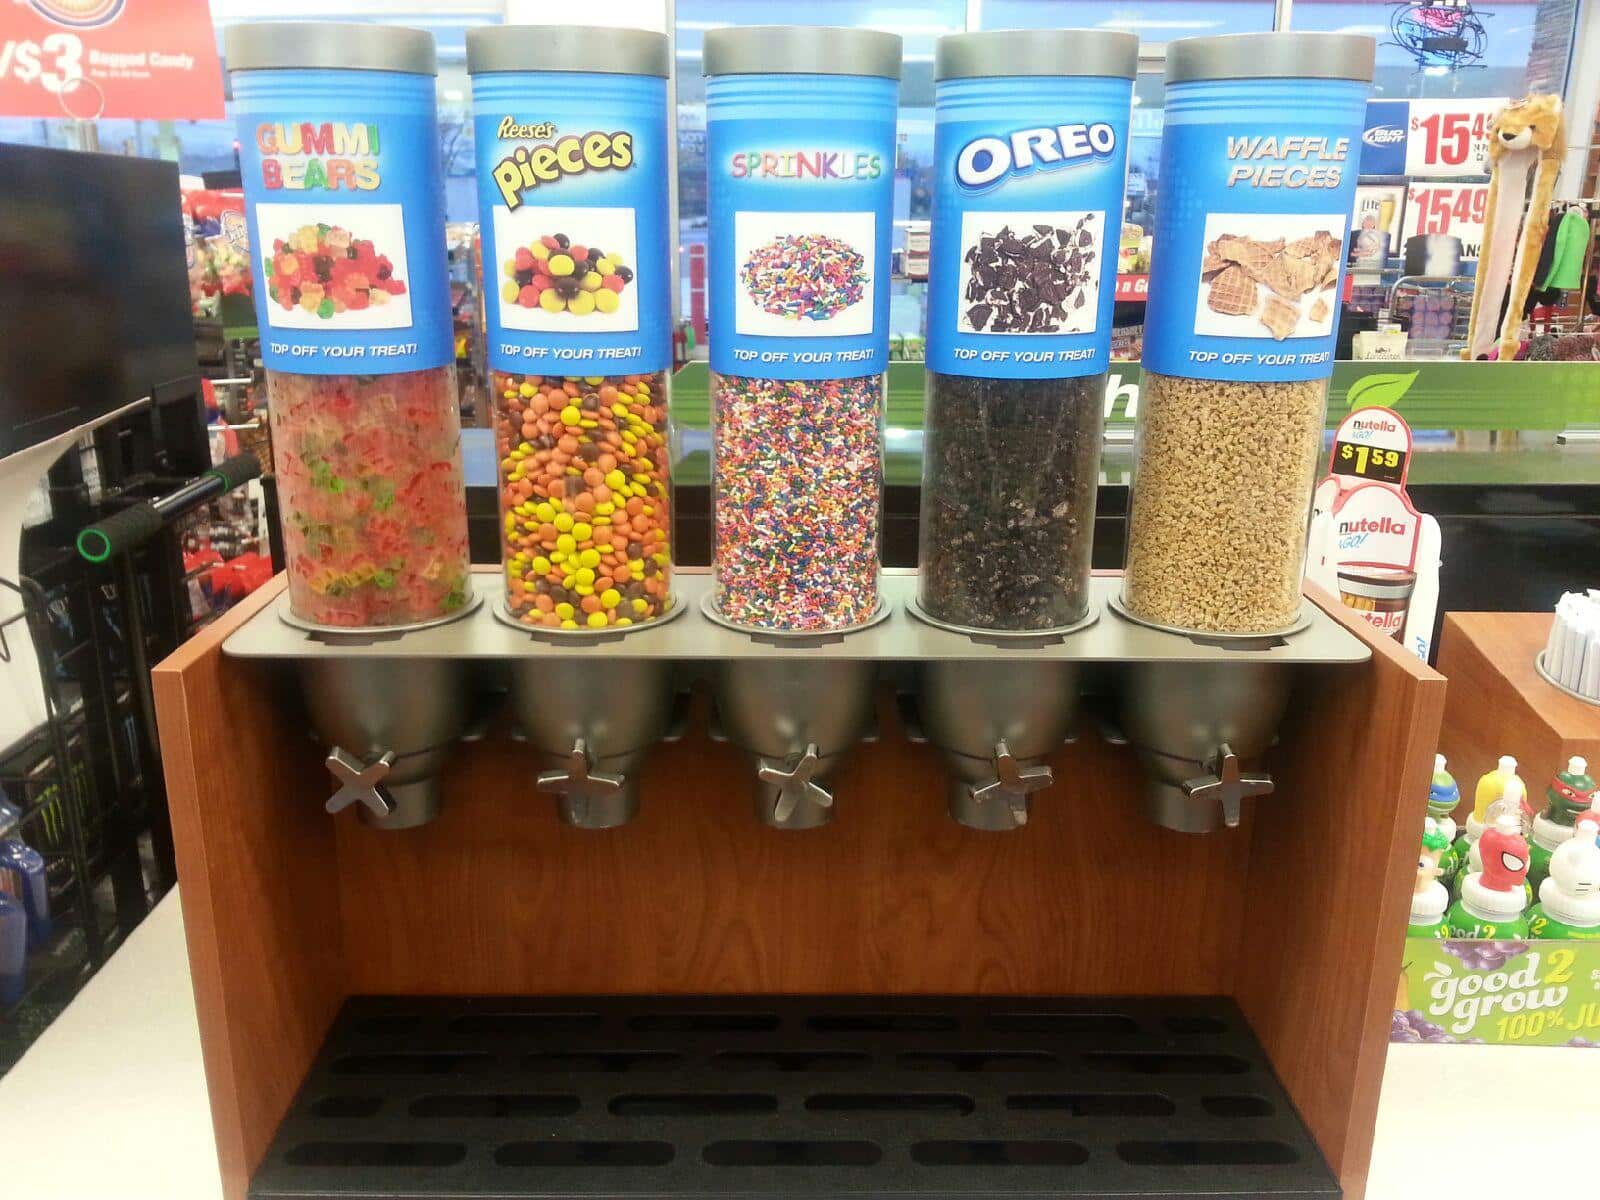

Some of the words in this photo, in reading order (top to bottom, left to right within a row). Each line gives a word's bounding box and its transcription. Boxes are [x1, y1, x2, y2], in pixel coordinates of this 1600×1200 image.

[149, 52, 194, 71] Candy
[256, 121, 380, 156] GUMMI
[497, 115, 555, 139] Reese's
[956, 122, 1116, 187] OREO
[1227, 136, 1349, 161] WAFFLE
[262, 158, 380, 191] BEARS
[492, 130, 633, 211] pieces
[731, 151, 881, 180] SPRINKLES
[1227, 165, 1342, 189] PIECES
[271, 342, 288, 355] TOP
[292, 344, 318, 356] OFF
[322, 345, 365, 358] YOUR
[371, 343, 417, 356] TREAT!
[501, 344, 520, 356] TOP
[523, 346, 548, 358] OFF
[553, 348, 593, 360] YOUR
[598, 346, 642, 359] TREAT!
[733, 349, 758, 361] TOP
[761, 351, 788, 363] OFF
[793, 352, 832, 363] YOUR
[836, 349, 874, 362] TREAT!
[953, 348, 977, 360] TOP
[981, 350, 1009, 362] OFF
[1014, 351, 1054, 362] YOUR
[1058, 349, 1096, 361] TREAT!
[1188, 350, 1218, 362] TOP
[1222, 351, 1253, 364] OFF
[1257, 353, 1297, 365] YOUR
[1353, 420, 1397, 433] nutella
[1339, 517, 1406, 535] nutella
[1428, 952, 1541, 1016] good
[1543, 948, 1576, 984] 2
[1450, 985, 1569, 1035] grow
[1497, 1008, 1563, 1042] 100%
